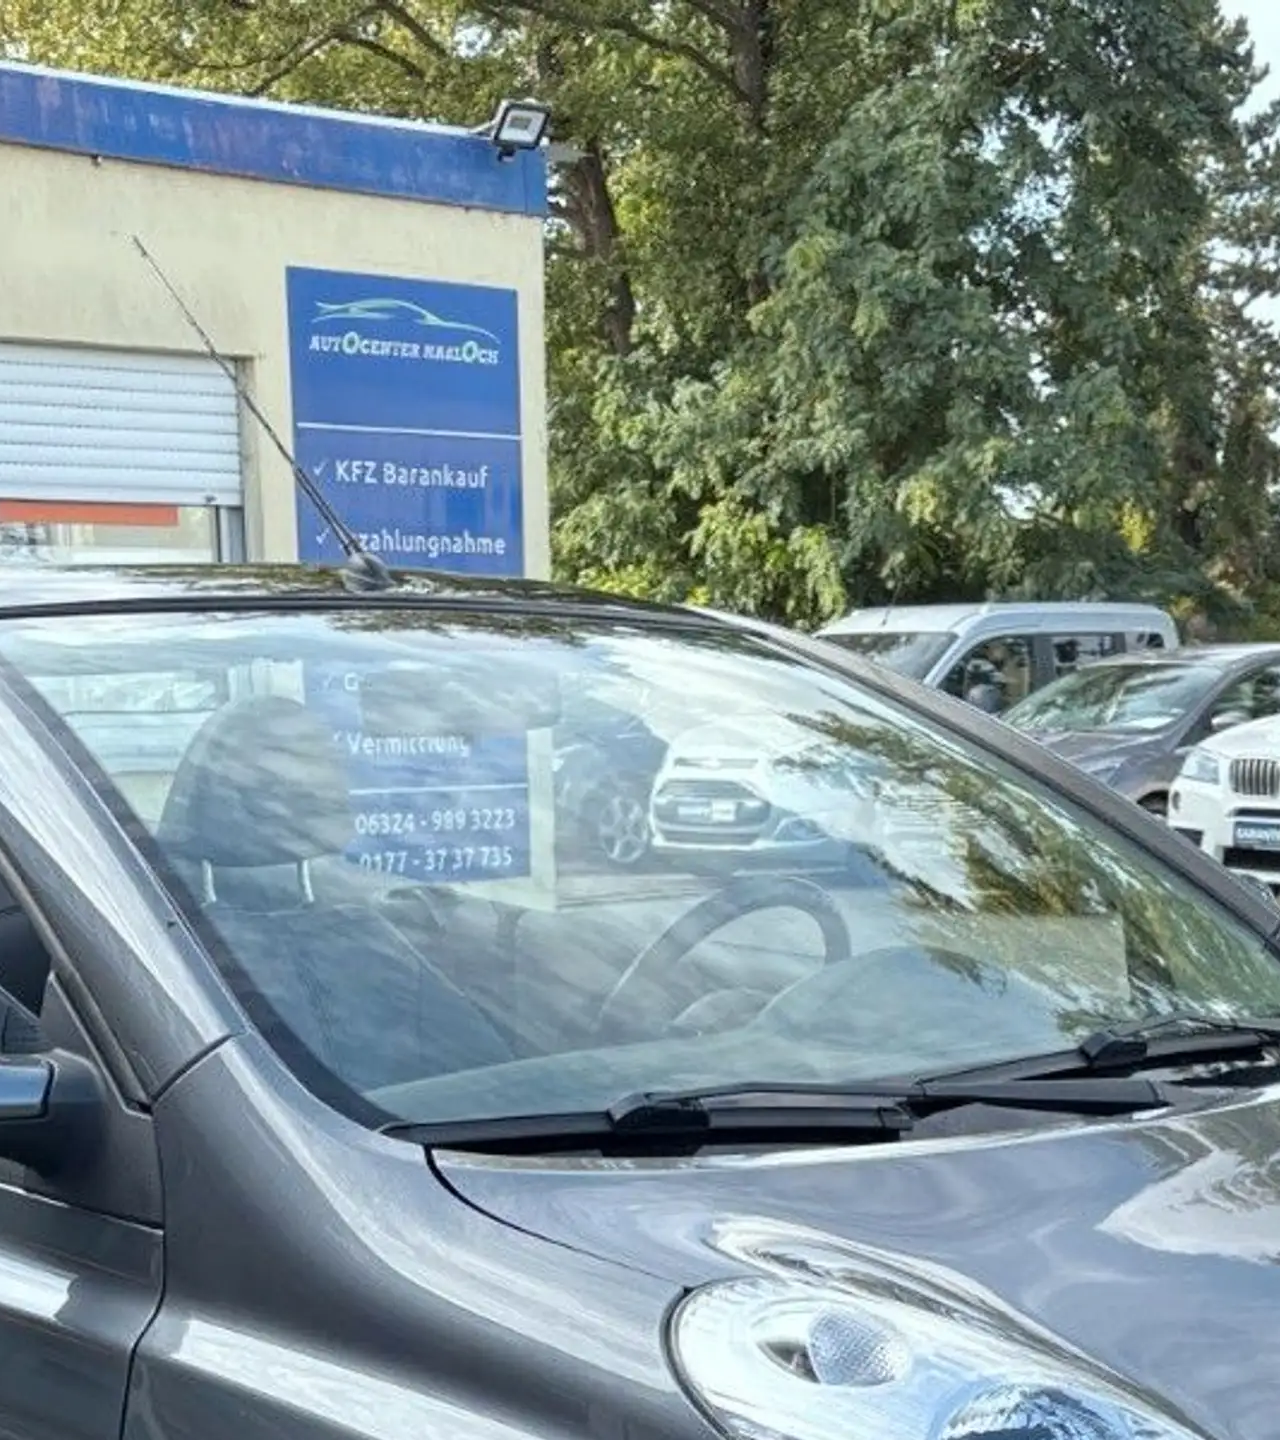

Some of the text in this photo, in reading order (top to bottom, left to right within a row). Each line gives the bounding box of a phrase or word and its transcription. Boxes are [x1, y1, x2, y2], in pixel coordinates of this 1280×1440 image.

[335, 459, 488, 489] KFZ Barankauf
[338, 527, 507, 558] zahlungnahme
[354, 812, 415, 836] 06324
[470, 808, 516, 830] 3223
[477, 845, 513, 867] 735
